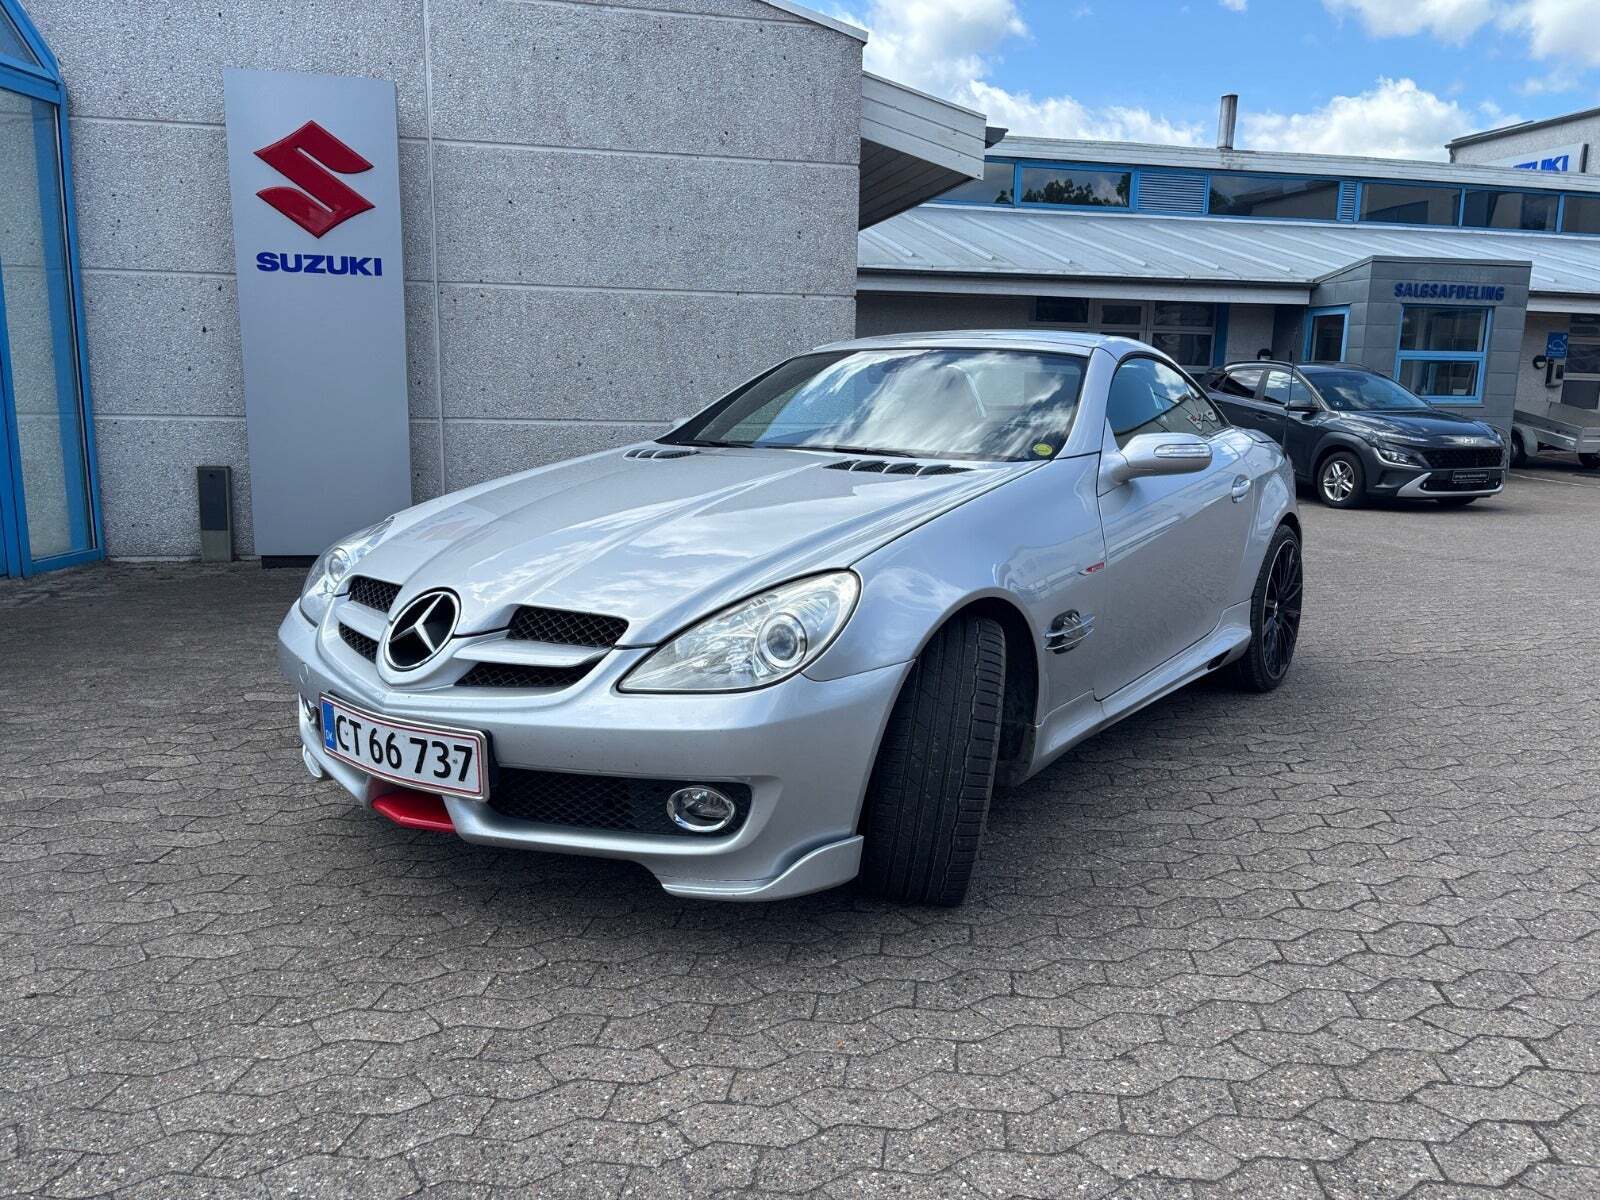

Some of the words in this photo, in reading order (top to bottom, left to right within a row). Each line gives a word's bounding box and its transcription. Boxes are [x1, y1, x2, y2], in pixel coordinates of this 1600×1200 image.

[256, 251, 383, 277] SUZUKI
[1394, 282, 1505, 302] SALGSAFDELING
[336, 714, 362, 757] CT
[369, 727, 403, 770] 66
[409, 736, 473, 783] 737
